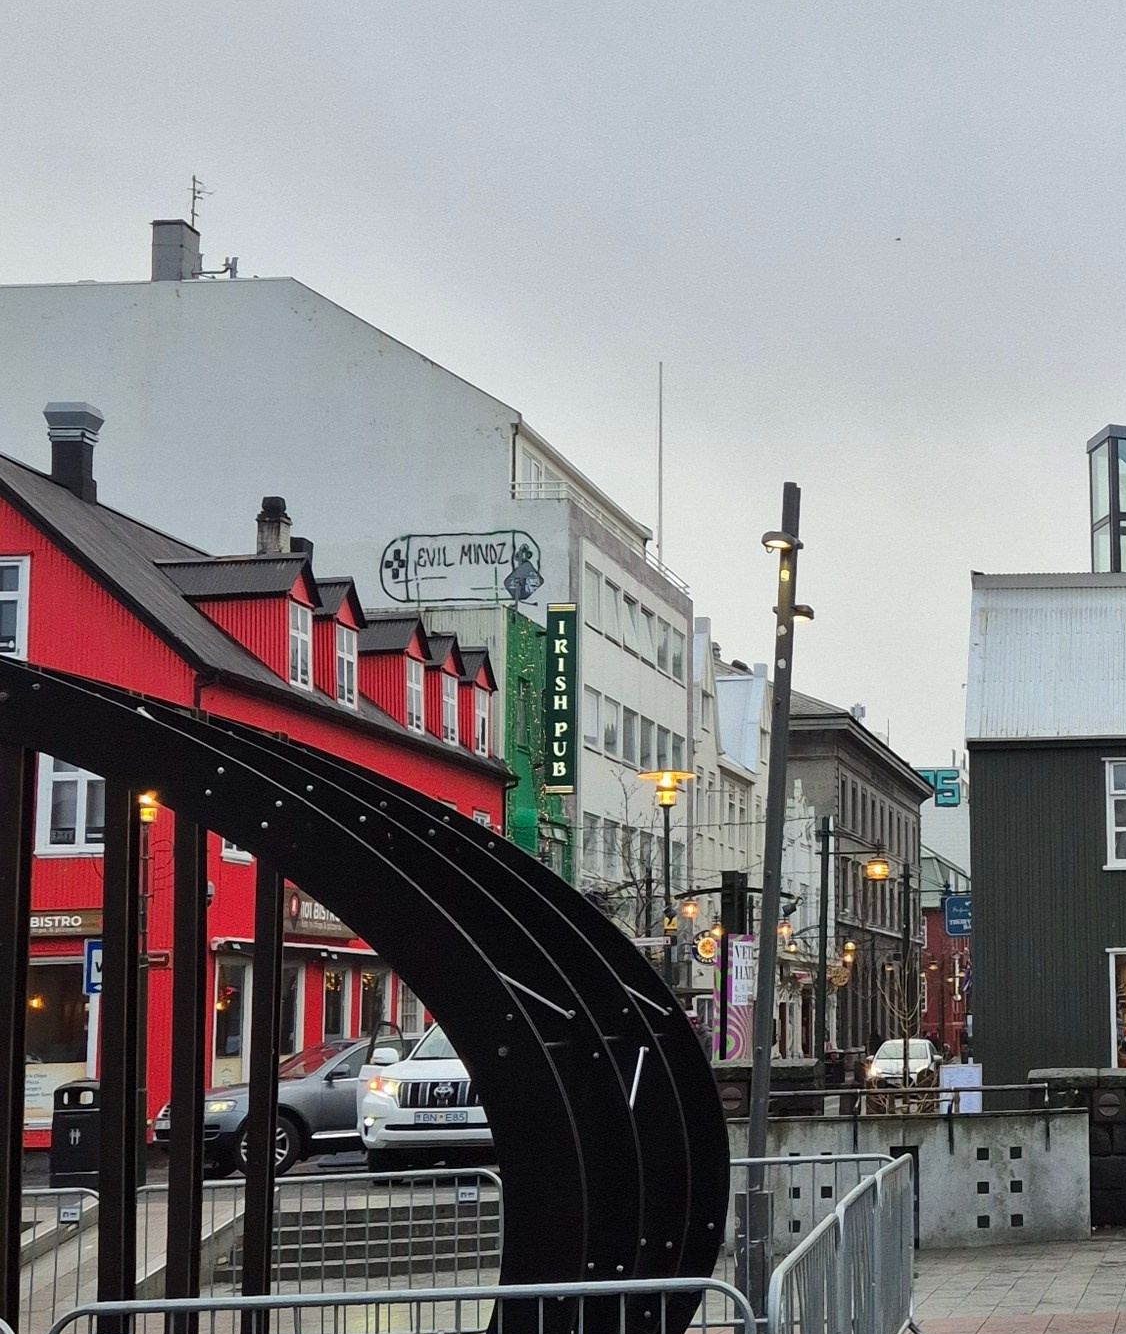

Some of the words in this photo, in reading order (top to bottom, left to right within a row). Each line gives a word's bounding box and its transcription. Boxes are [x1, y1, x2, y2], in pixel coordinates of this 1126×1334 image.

[417, 546, 455, 567] EVIL
[459, 542, 510, 566] MINDZ
[553, 620, 569, 710] IRISH
[552, 722, 568, 777] PUB
[29, 915, 82, 928] BISTRO
[301, 901, 312, 919] 101
